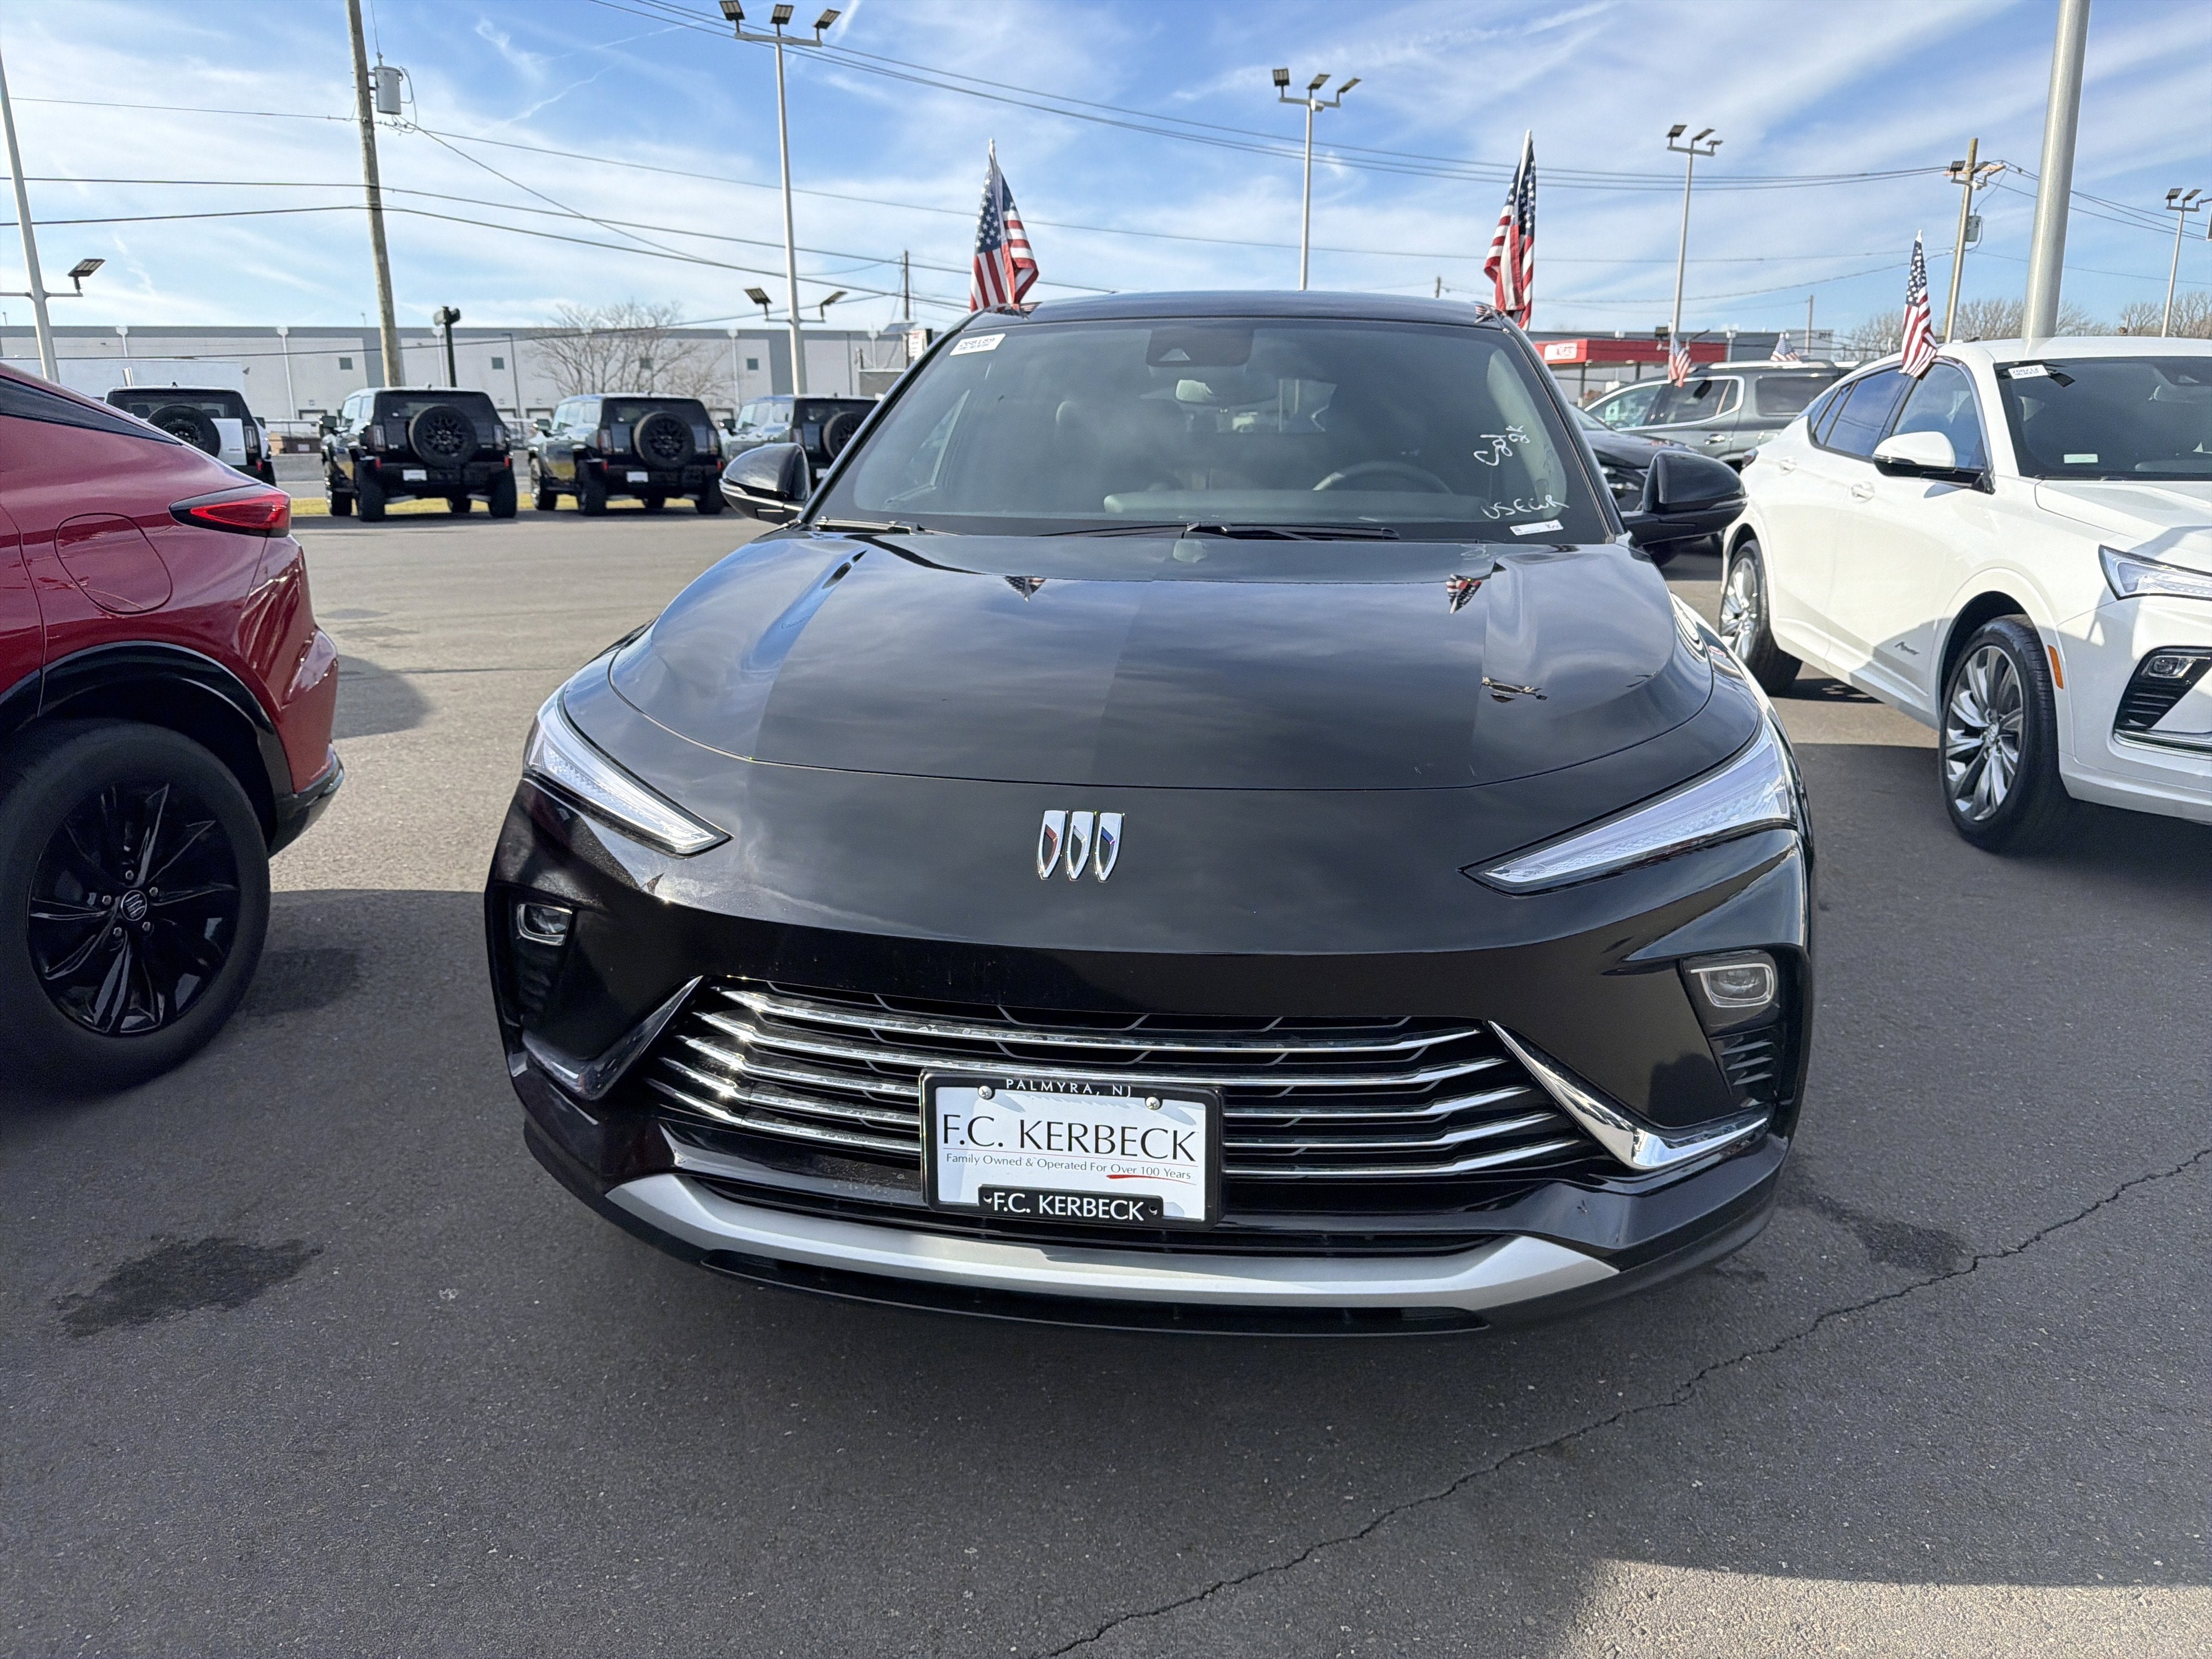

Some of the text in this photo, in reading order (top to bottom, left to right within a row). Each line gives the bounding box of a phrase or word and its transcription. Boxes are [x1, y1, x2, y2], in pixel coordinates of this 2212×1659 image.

[1006, 1079, 1131, 1098] PALMYRA, NJ
[944, 1114, 1197, 1162] F.C. KERBECK
[946, 1153, 1191, 1180] Family Owned & Operated For Over 100 Years
[994, 1192, 1144, 1221] F.C. KERBECK
